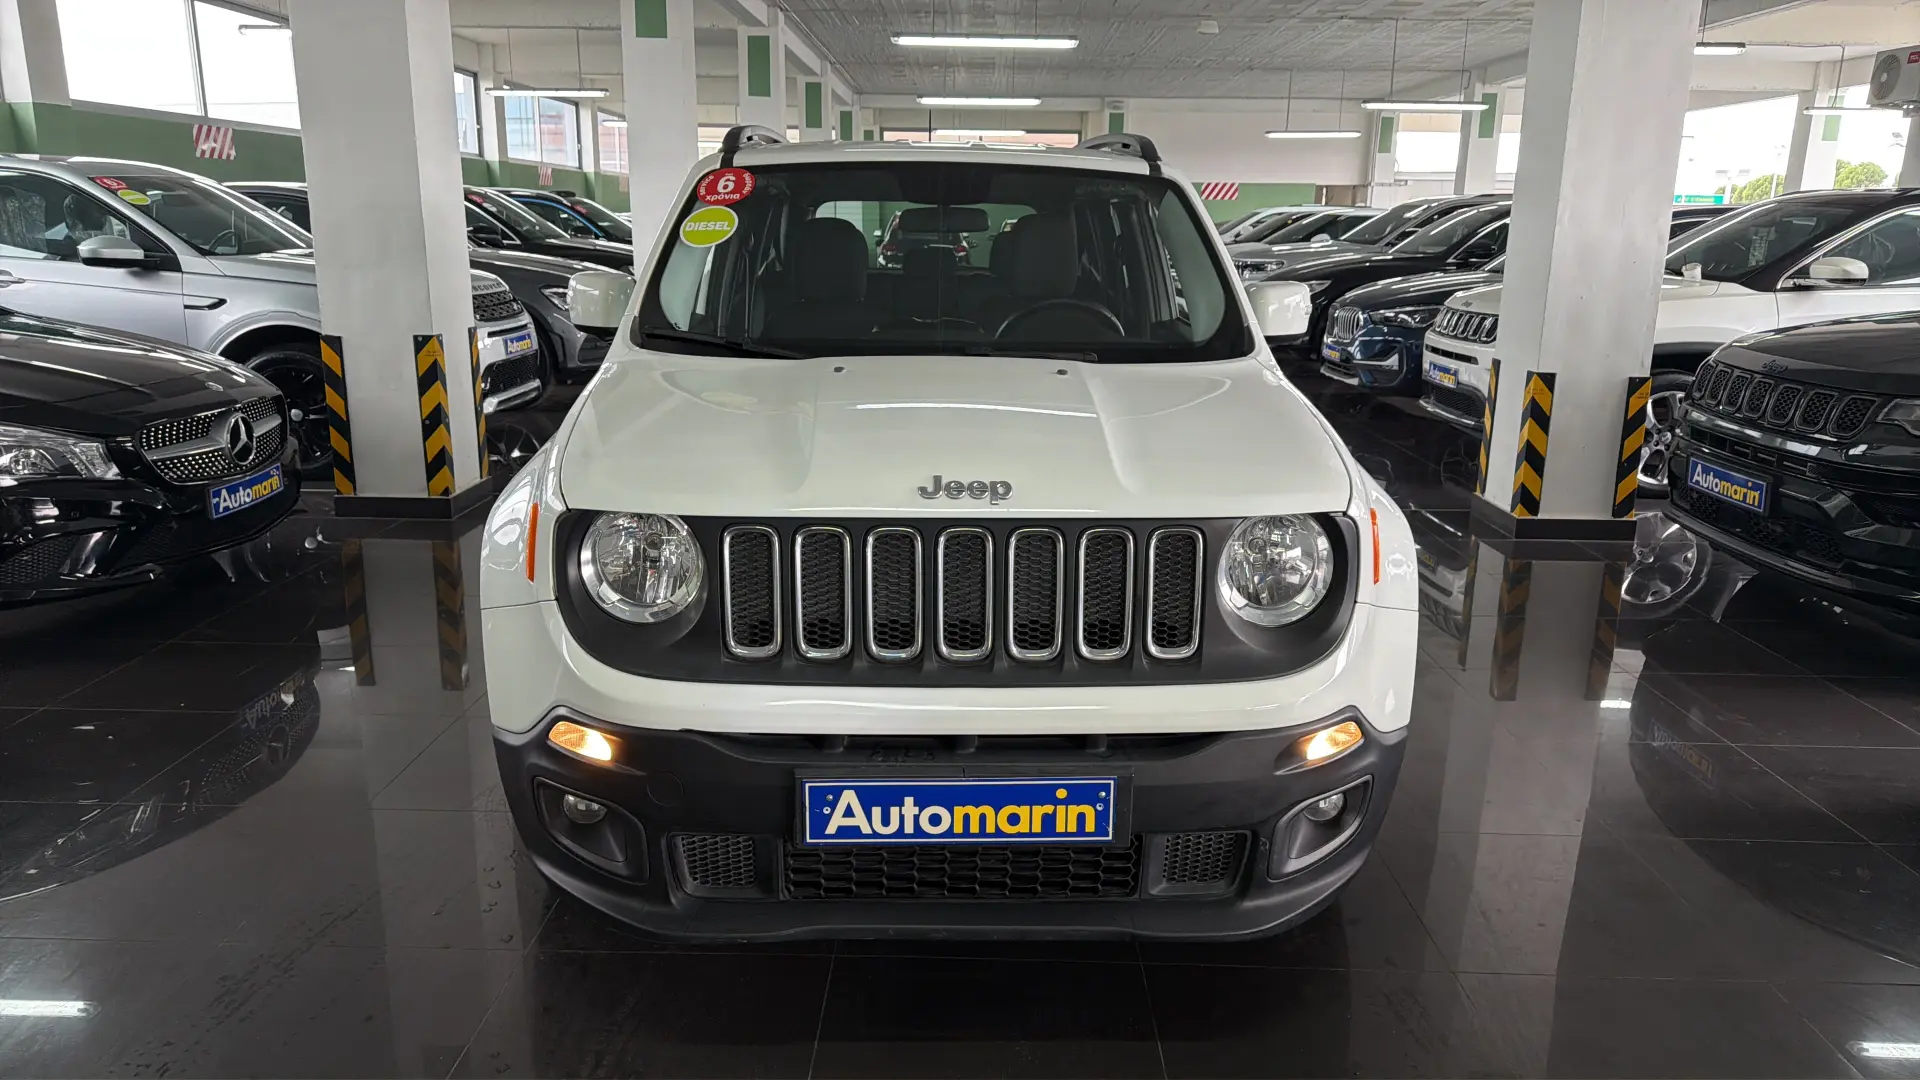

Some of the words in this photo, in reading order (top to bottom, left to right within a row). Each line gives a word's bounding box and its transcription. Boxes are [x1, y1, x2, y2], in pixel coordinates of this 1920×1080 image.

[717, 175, 736, 193] 6
[705, 193, 740, 202] χρόνια
[685, 221, 731, 231] DIESEL
[917, 474, 1013, 506] Jeep
[1692, 463, 1760, 507] Automarin
[824, 788, 1096, 835] Automarin
